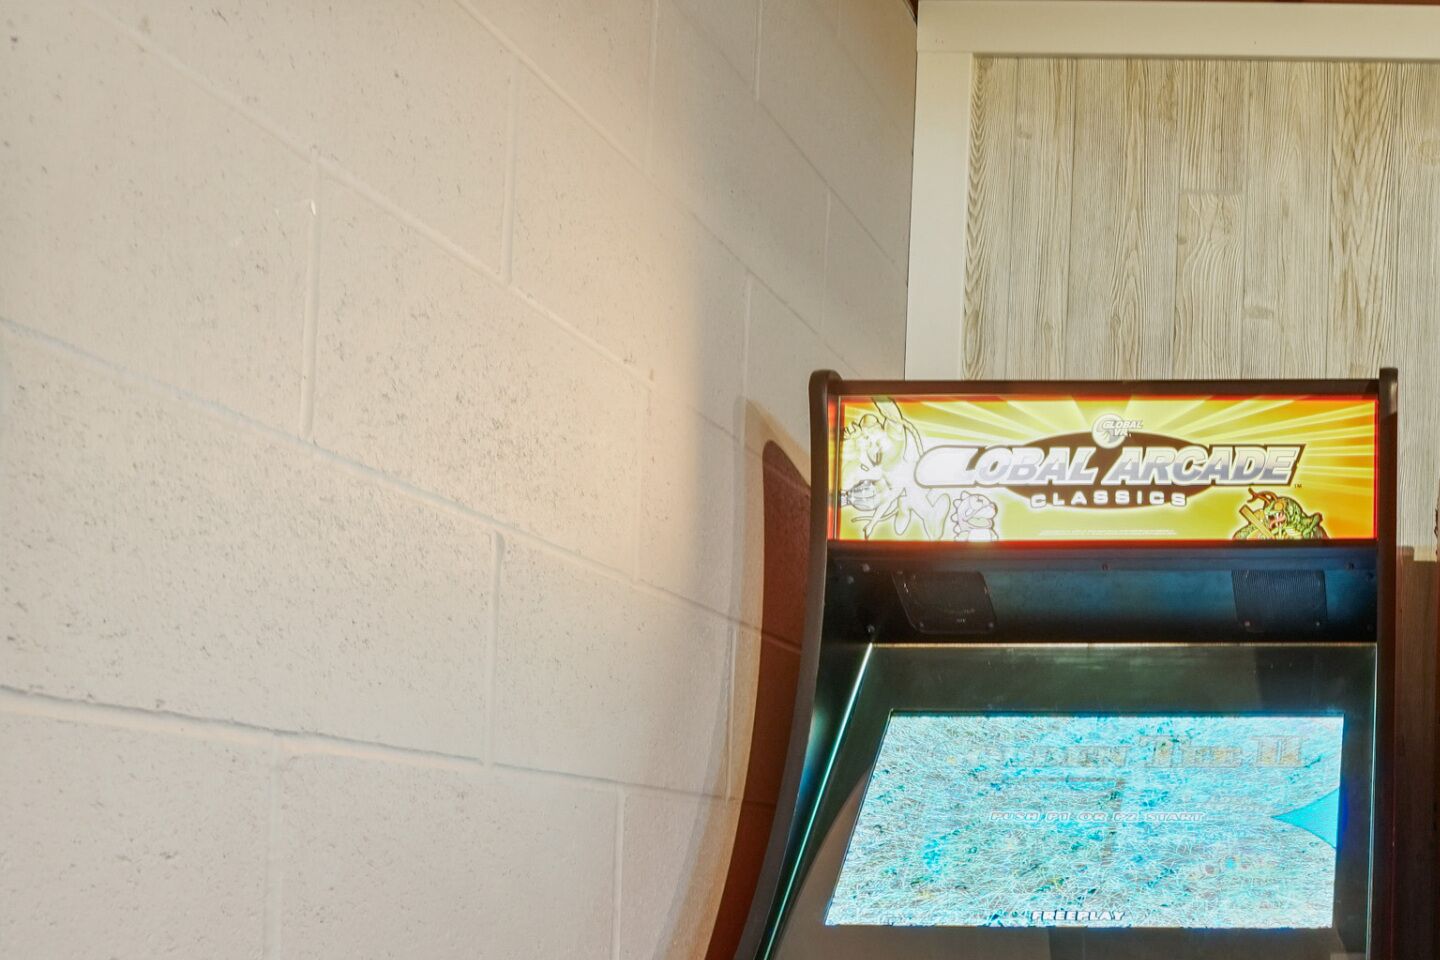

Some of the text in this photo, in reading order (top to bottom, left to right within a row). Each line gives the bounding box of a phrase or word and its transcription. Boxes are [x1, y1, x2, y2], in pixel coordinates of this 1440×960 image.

[1100, 445, 1303, 486] ARCADE
[1031, 489, 1187, 508] CLASSICS
[991, 811, 1205, 822] PUSH P1 OR P2 START
